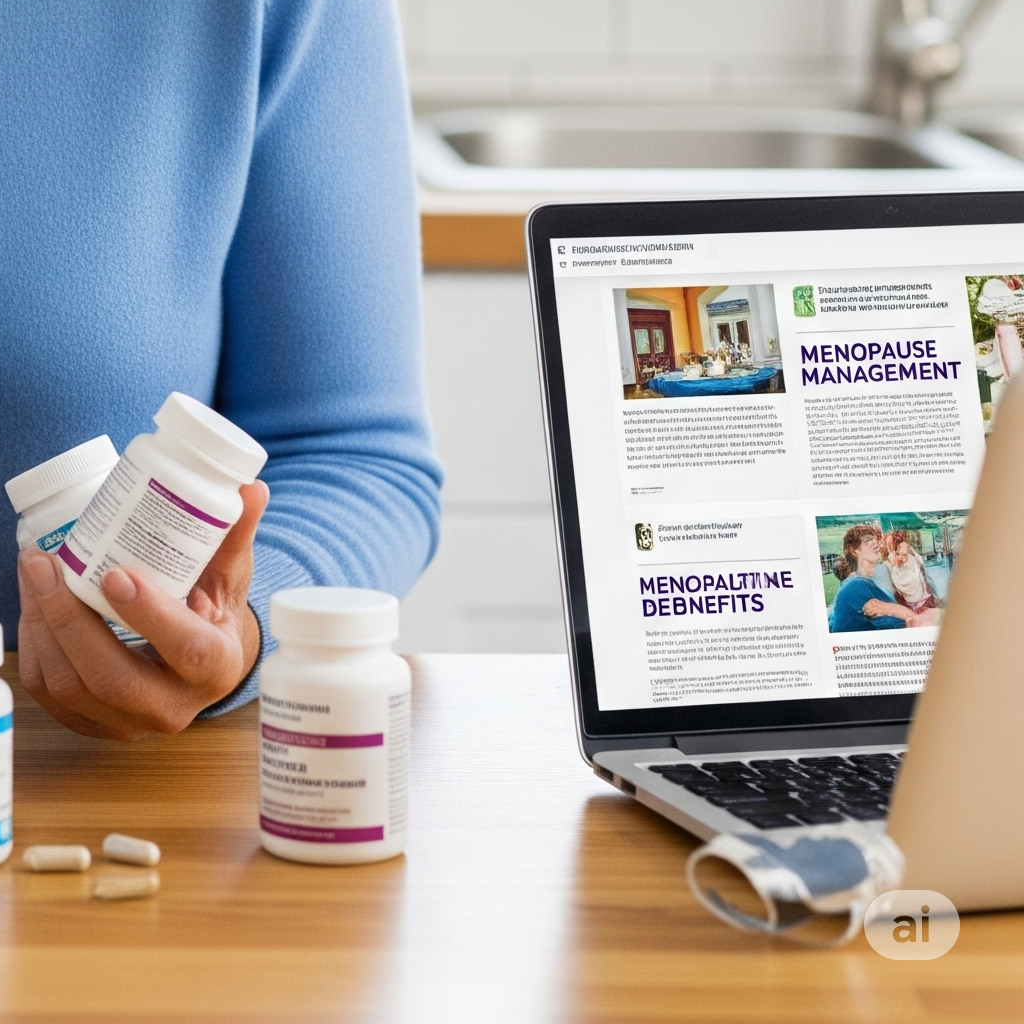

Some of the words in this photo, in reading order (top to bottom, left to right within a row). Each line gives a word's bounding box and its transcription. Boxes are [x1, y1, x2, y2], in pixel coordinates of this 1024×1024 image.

[800, 339, 938, 364] MENOPAUSE
[801, 361, 962, 386] MANAGEMENT
[642, 593, 765, 617] DEBNEFITS
